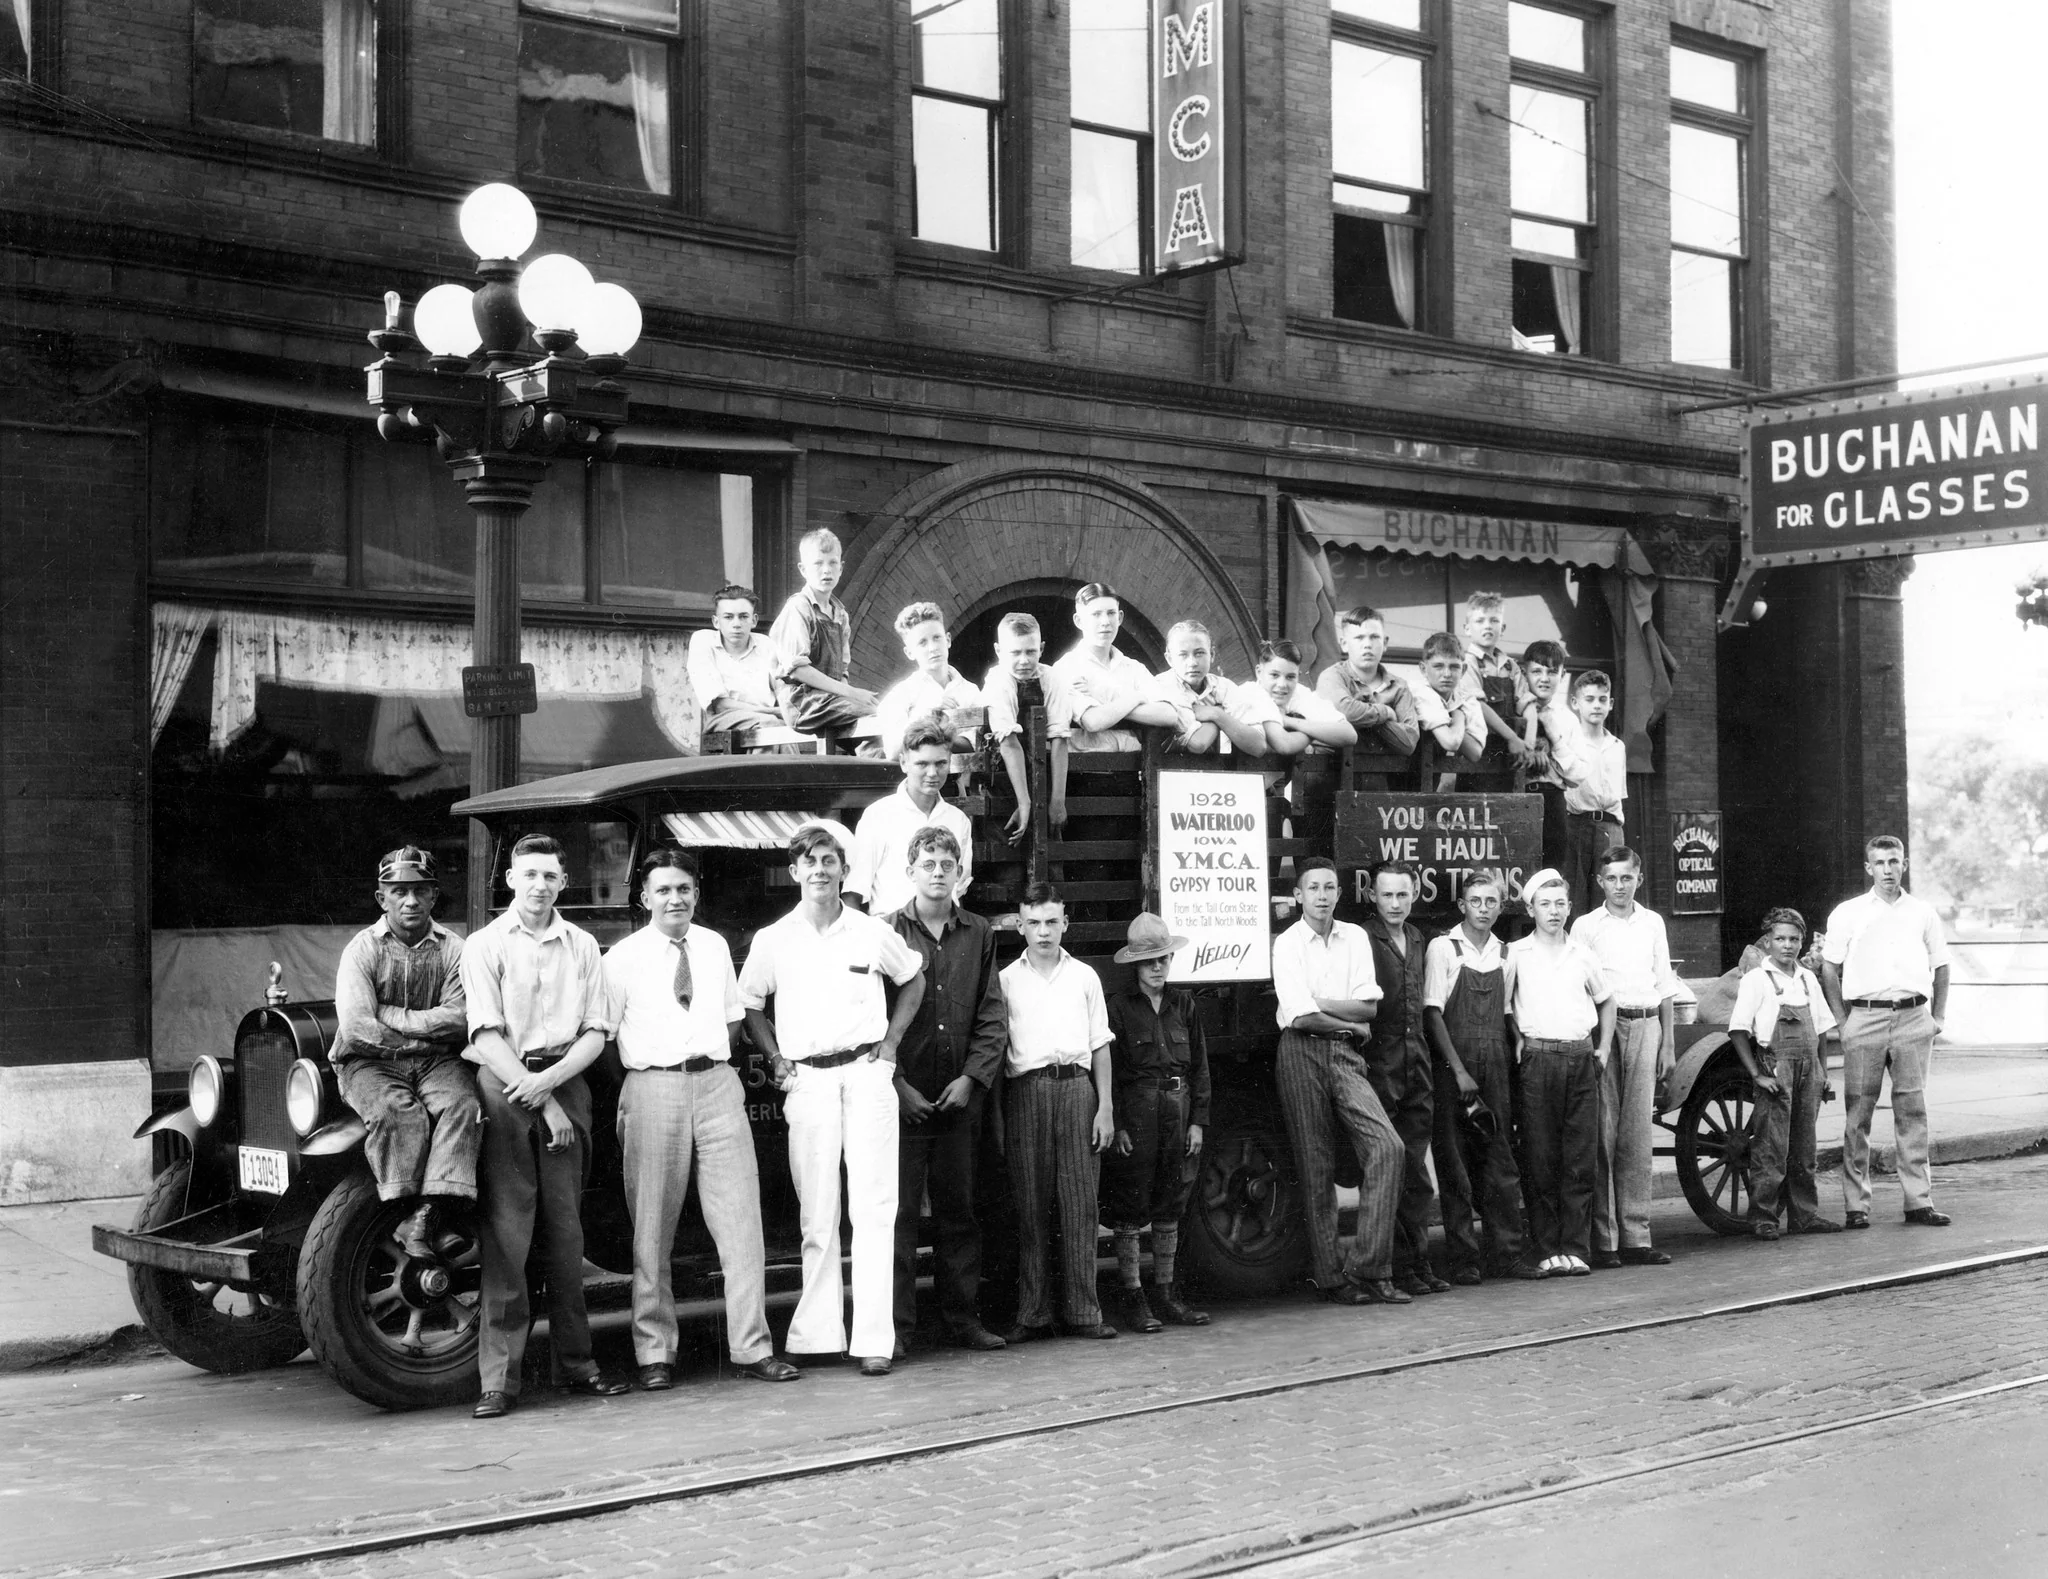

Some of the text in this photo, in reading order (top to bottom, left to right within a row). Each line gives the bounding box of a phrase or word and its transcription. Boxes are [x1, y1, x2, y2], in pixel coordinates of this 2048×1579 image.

[1771, 403, 2038, 483] BUCHANAN
[1776, 469, 2030, 529] FOR GLASSES
[1383, 509, 1560, 556] BUCHANAN
[465, 669, 533, 683] PARKING LIMIT
[1189, 792, 1237, 807] 1928
[1170, 812, 1255, 831] WATERLOO
[1377, 807, 1498, 831] YOU CALL
[1194, 836, 1237, 845] IOWA
[1379, 837, 1501, 861] WE HAUL
[1672, 827, 1719, 854] BUCHANAN
[1172, 851, 1261, 870] Y.M.C.A.
[1678, 857, 1715, 872] OPTICAL
[1170, 876, 1257, 893] GYPSY TOUR
[1446, 867, 1523, 902] TNS
[1676, 879, 1718, 894] COMPANY
[1174, 902, 1258, 914] From the Tall Corn State
[1175, 915, 1258, 927] To the Tall North Woods
[1191, 941, 1252, 974] HELLO!
[747, 1102, 783, 1121] ERL
